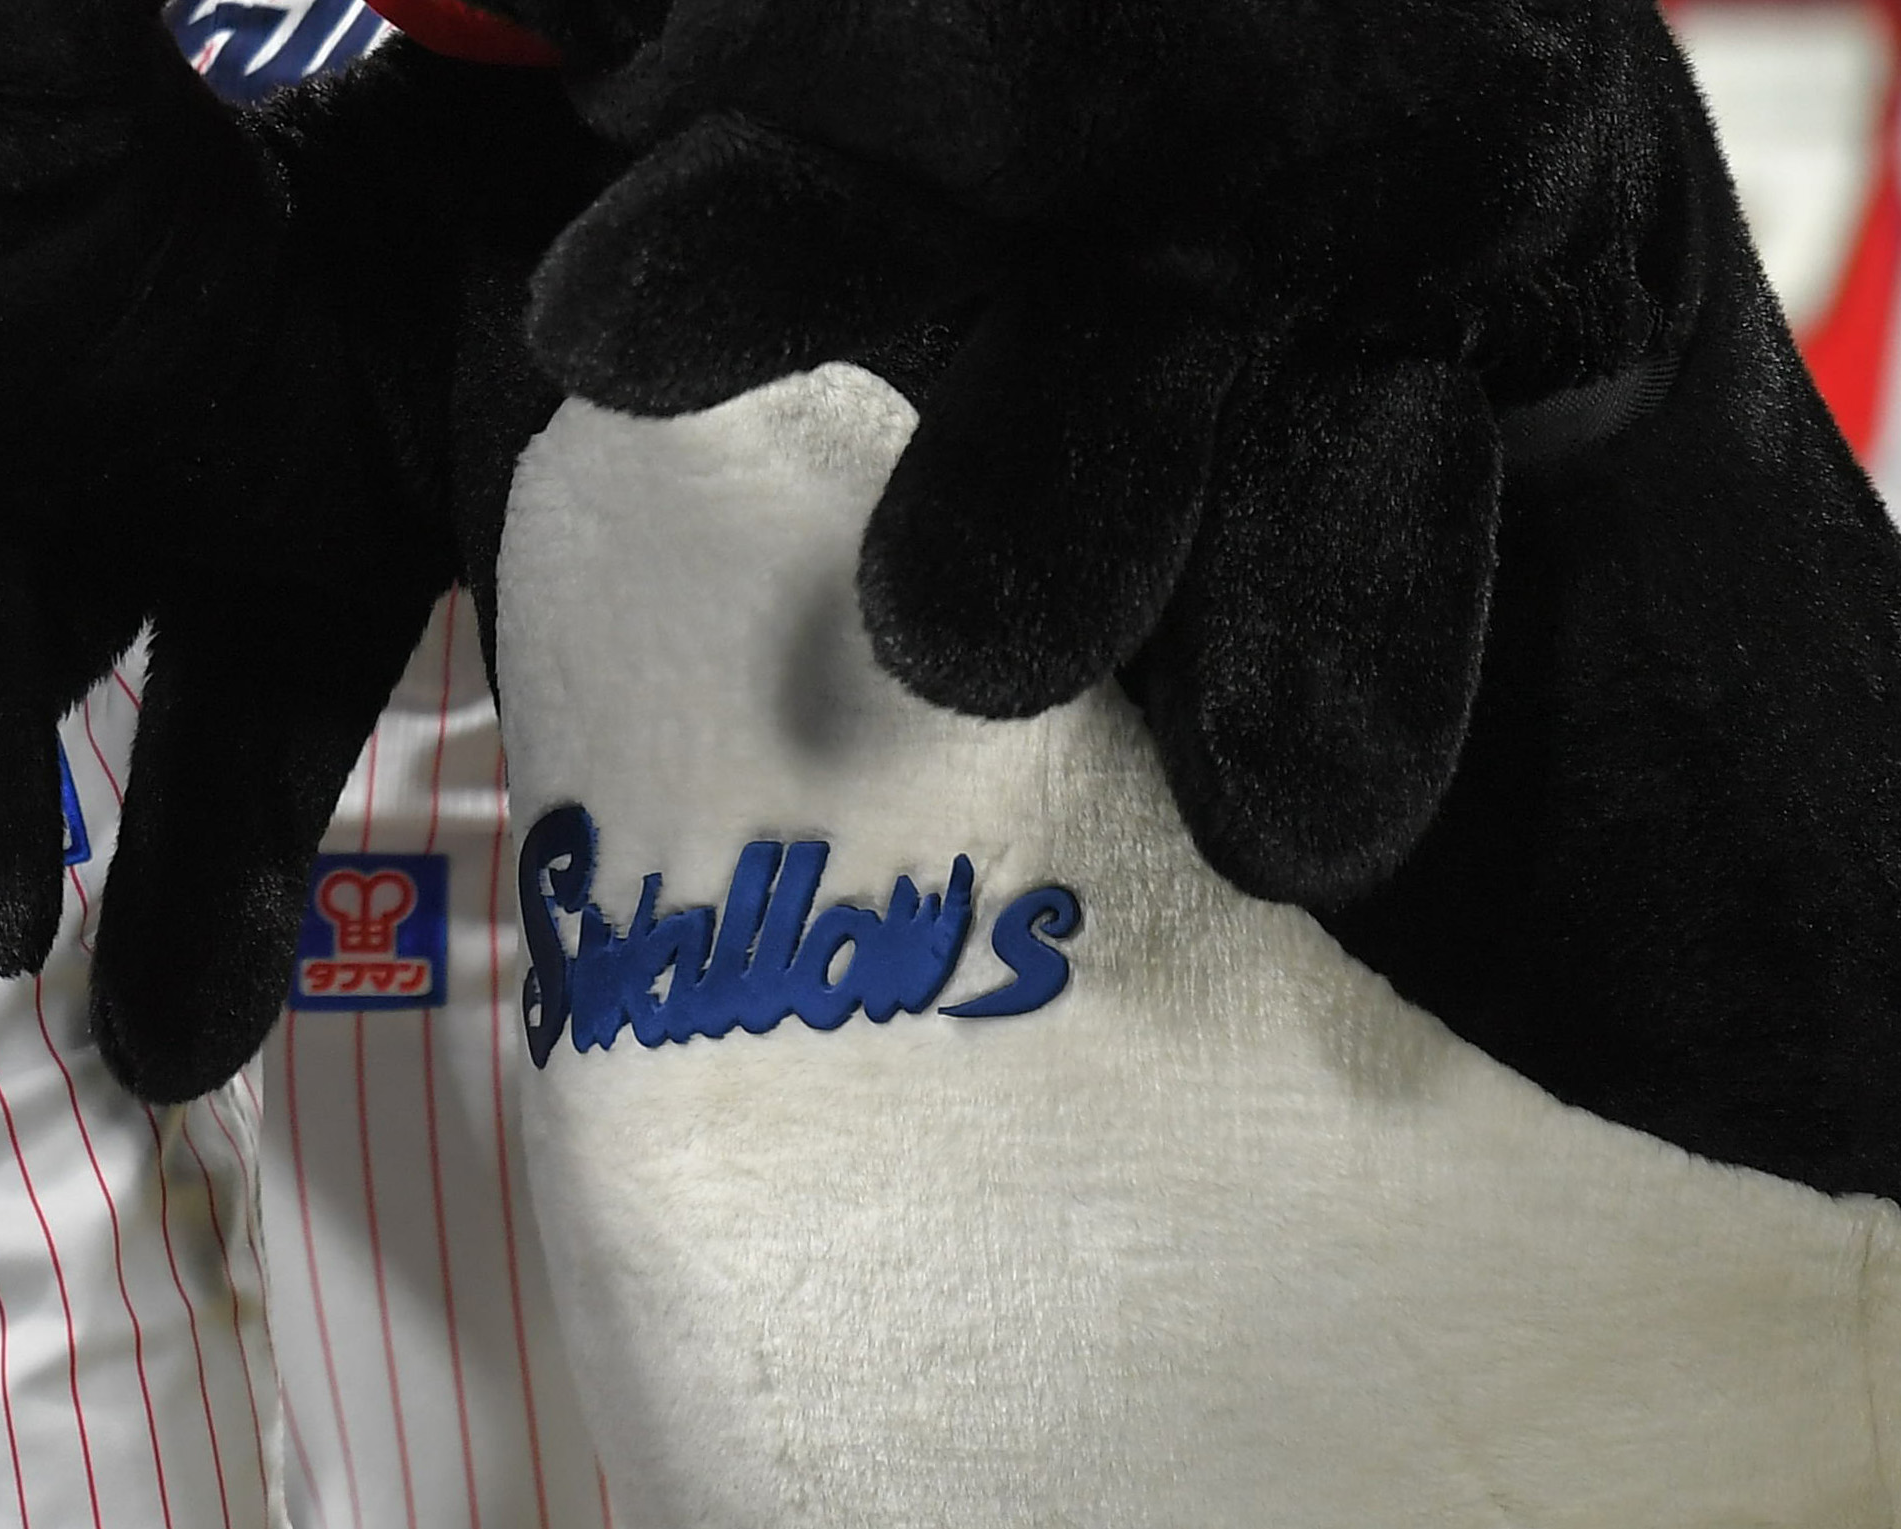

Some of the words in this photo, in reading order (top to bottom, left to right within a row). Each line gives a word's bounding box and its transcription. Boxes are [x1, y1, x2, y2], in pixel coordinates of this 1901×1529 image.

[305, 960, 429, 994] タフマン
[518, 803, 1082, 1070] Swallows
